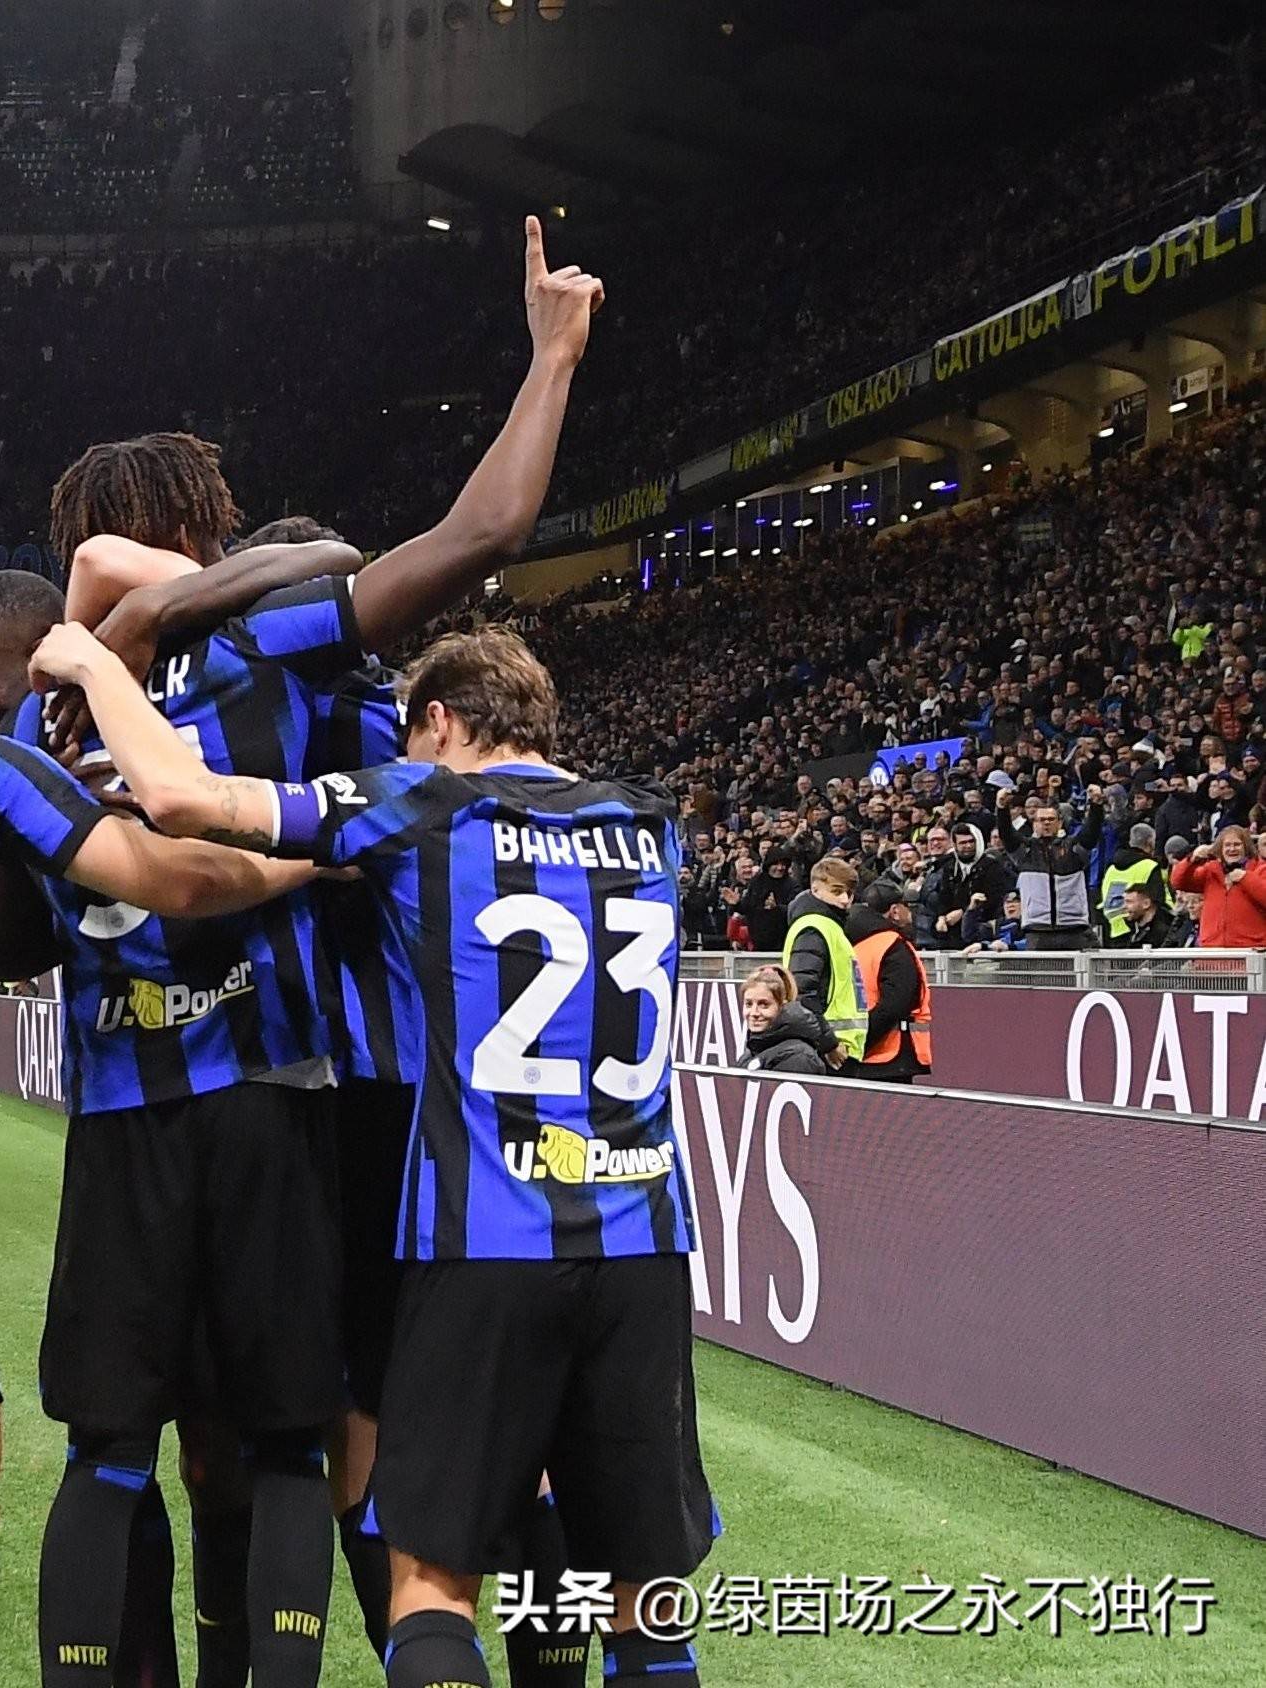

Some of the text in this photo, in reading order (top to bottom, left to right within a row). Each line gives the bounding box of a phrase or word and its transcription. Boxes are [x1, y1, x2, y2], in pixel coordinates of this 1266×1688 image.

[935, 290, 1063, 383] CATTOLICA
[493, 822, 663, 873] BARELLA
[471, 894, 675, 1100] 23
[273, 1609, 321, 1639] INTER
[59, 1644, 108, 1666] INTER
